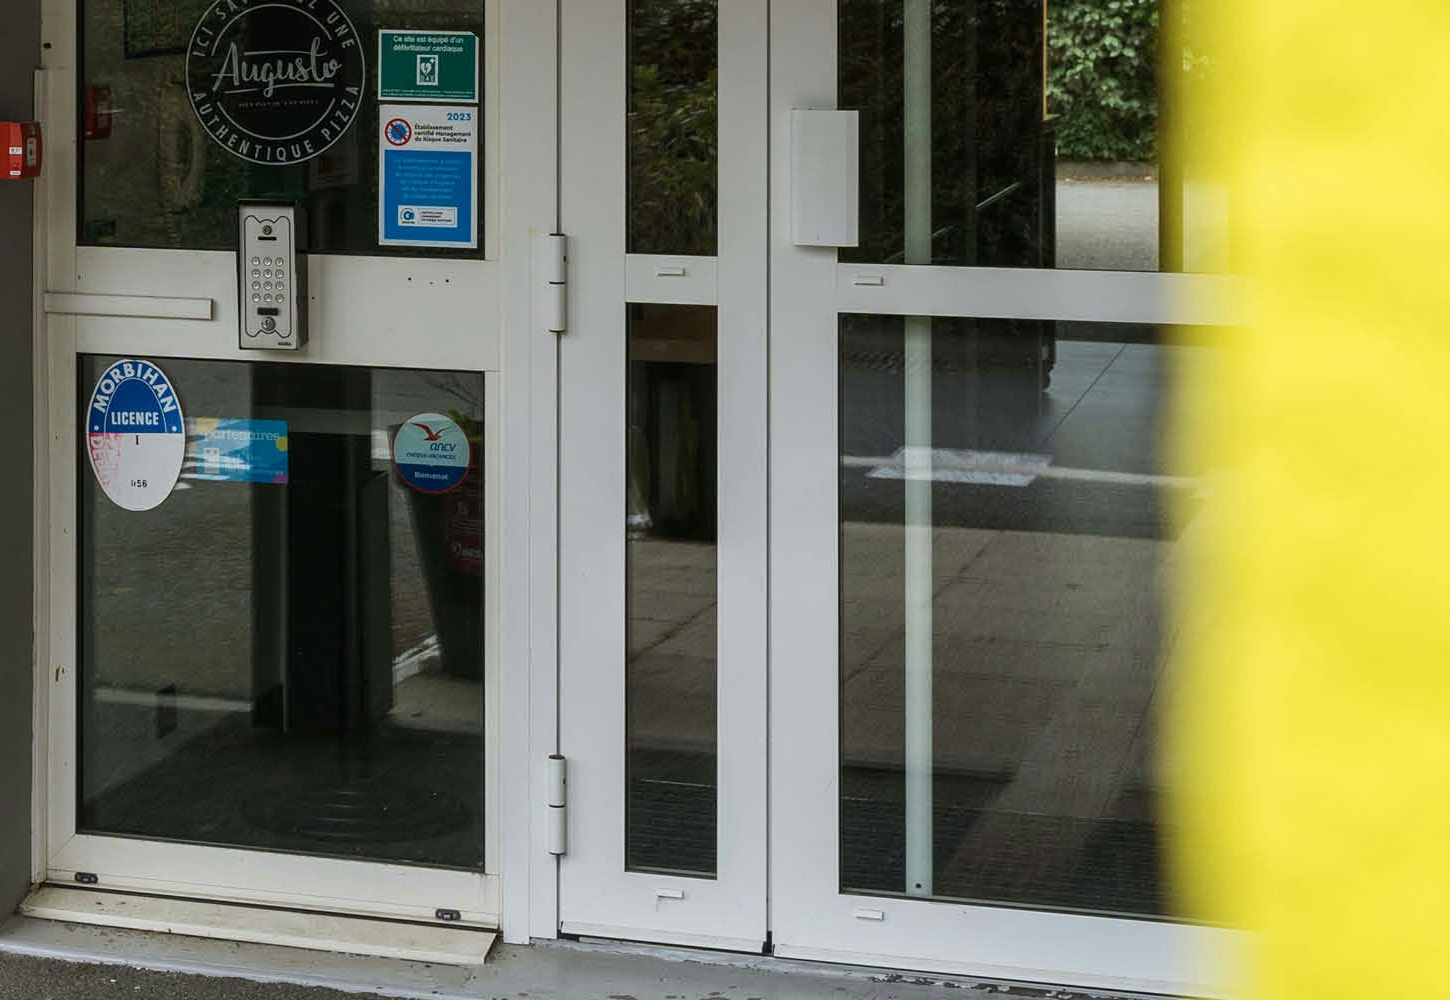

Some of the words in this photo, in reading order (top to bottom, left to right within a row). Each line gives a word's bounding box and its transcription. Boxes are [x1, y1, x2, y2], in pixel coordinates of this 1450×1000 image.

[192, 26, 214, 57] ICI
[327, 11, 356, 49] UNE
[392, 35, 403, 43] Ce
[210, 36, 343, 98] Augusto
[193, 91, 315, 162] AUTHENTIQUE
[320, 86, 359, 141] PIZZA
[446, 112, 472, 121] 2023
[93, 362, 177, 414] MORBIHAN
[111, 411, 159, 426] LICENCE
